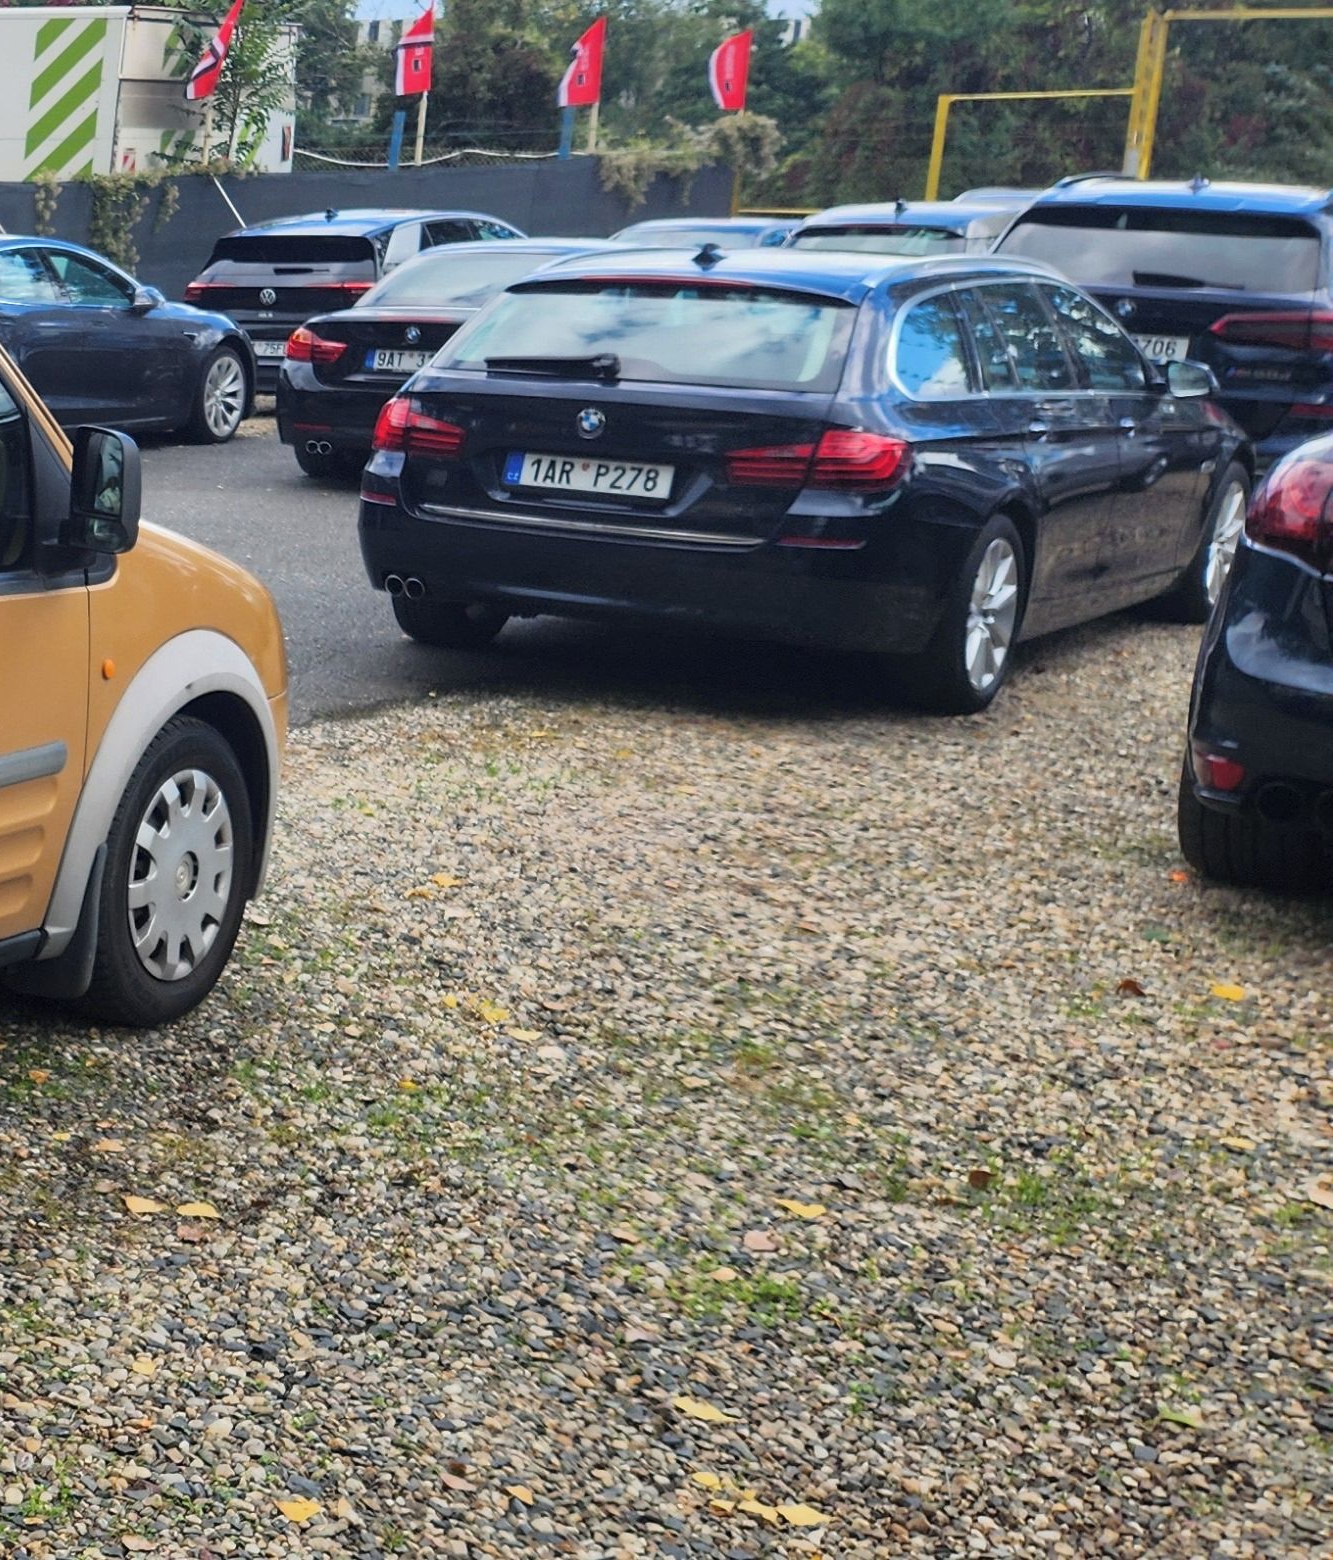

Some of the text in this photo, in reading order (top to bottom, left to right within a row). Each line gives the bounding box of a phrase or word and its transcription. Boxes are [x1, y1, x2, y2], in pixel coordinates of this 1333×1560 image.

[378, 352, 405, 367] 9AT
[531, 458, 659, 492] 1AR P278
